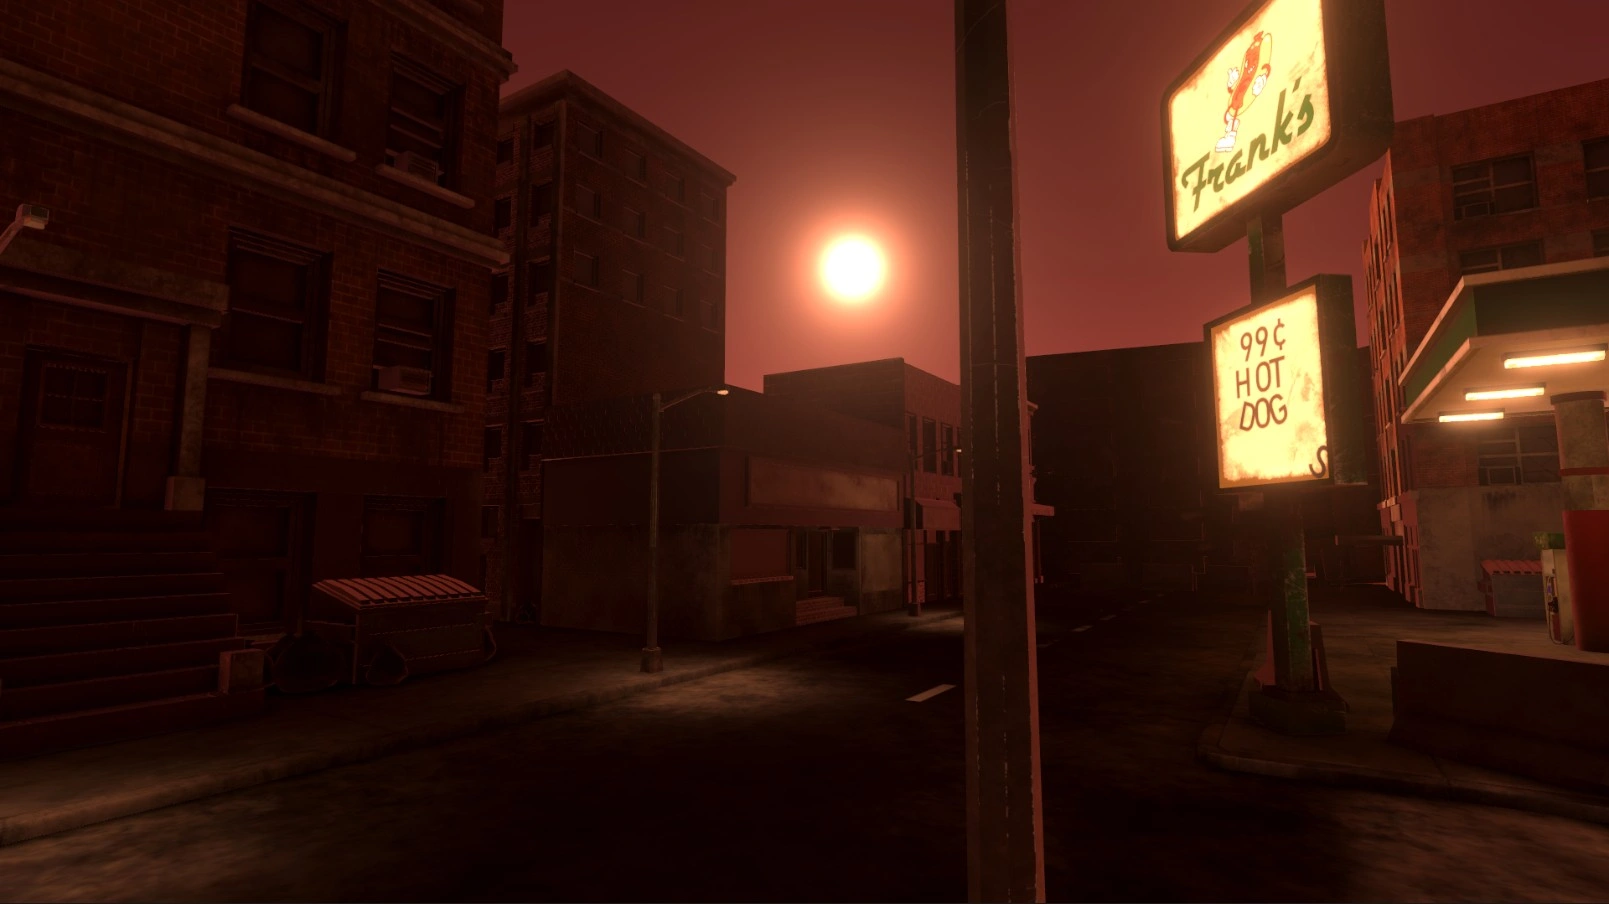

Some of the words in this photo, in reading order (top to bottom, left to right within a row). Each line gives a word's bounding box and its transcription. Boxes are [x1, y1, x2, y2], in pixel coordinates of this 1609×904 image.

[1181, 76, 1315, 213] Frank's
[1240, 318, 1286, 362] 99¢
[1236, 356, 1285, 399] HOT
[1239, 394, 1288, 431] DOG
[1309, 445, 1329, 478] S
